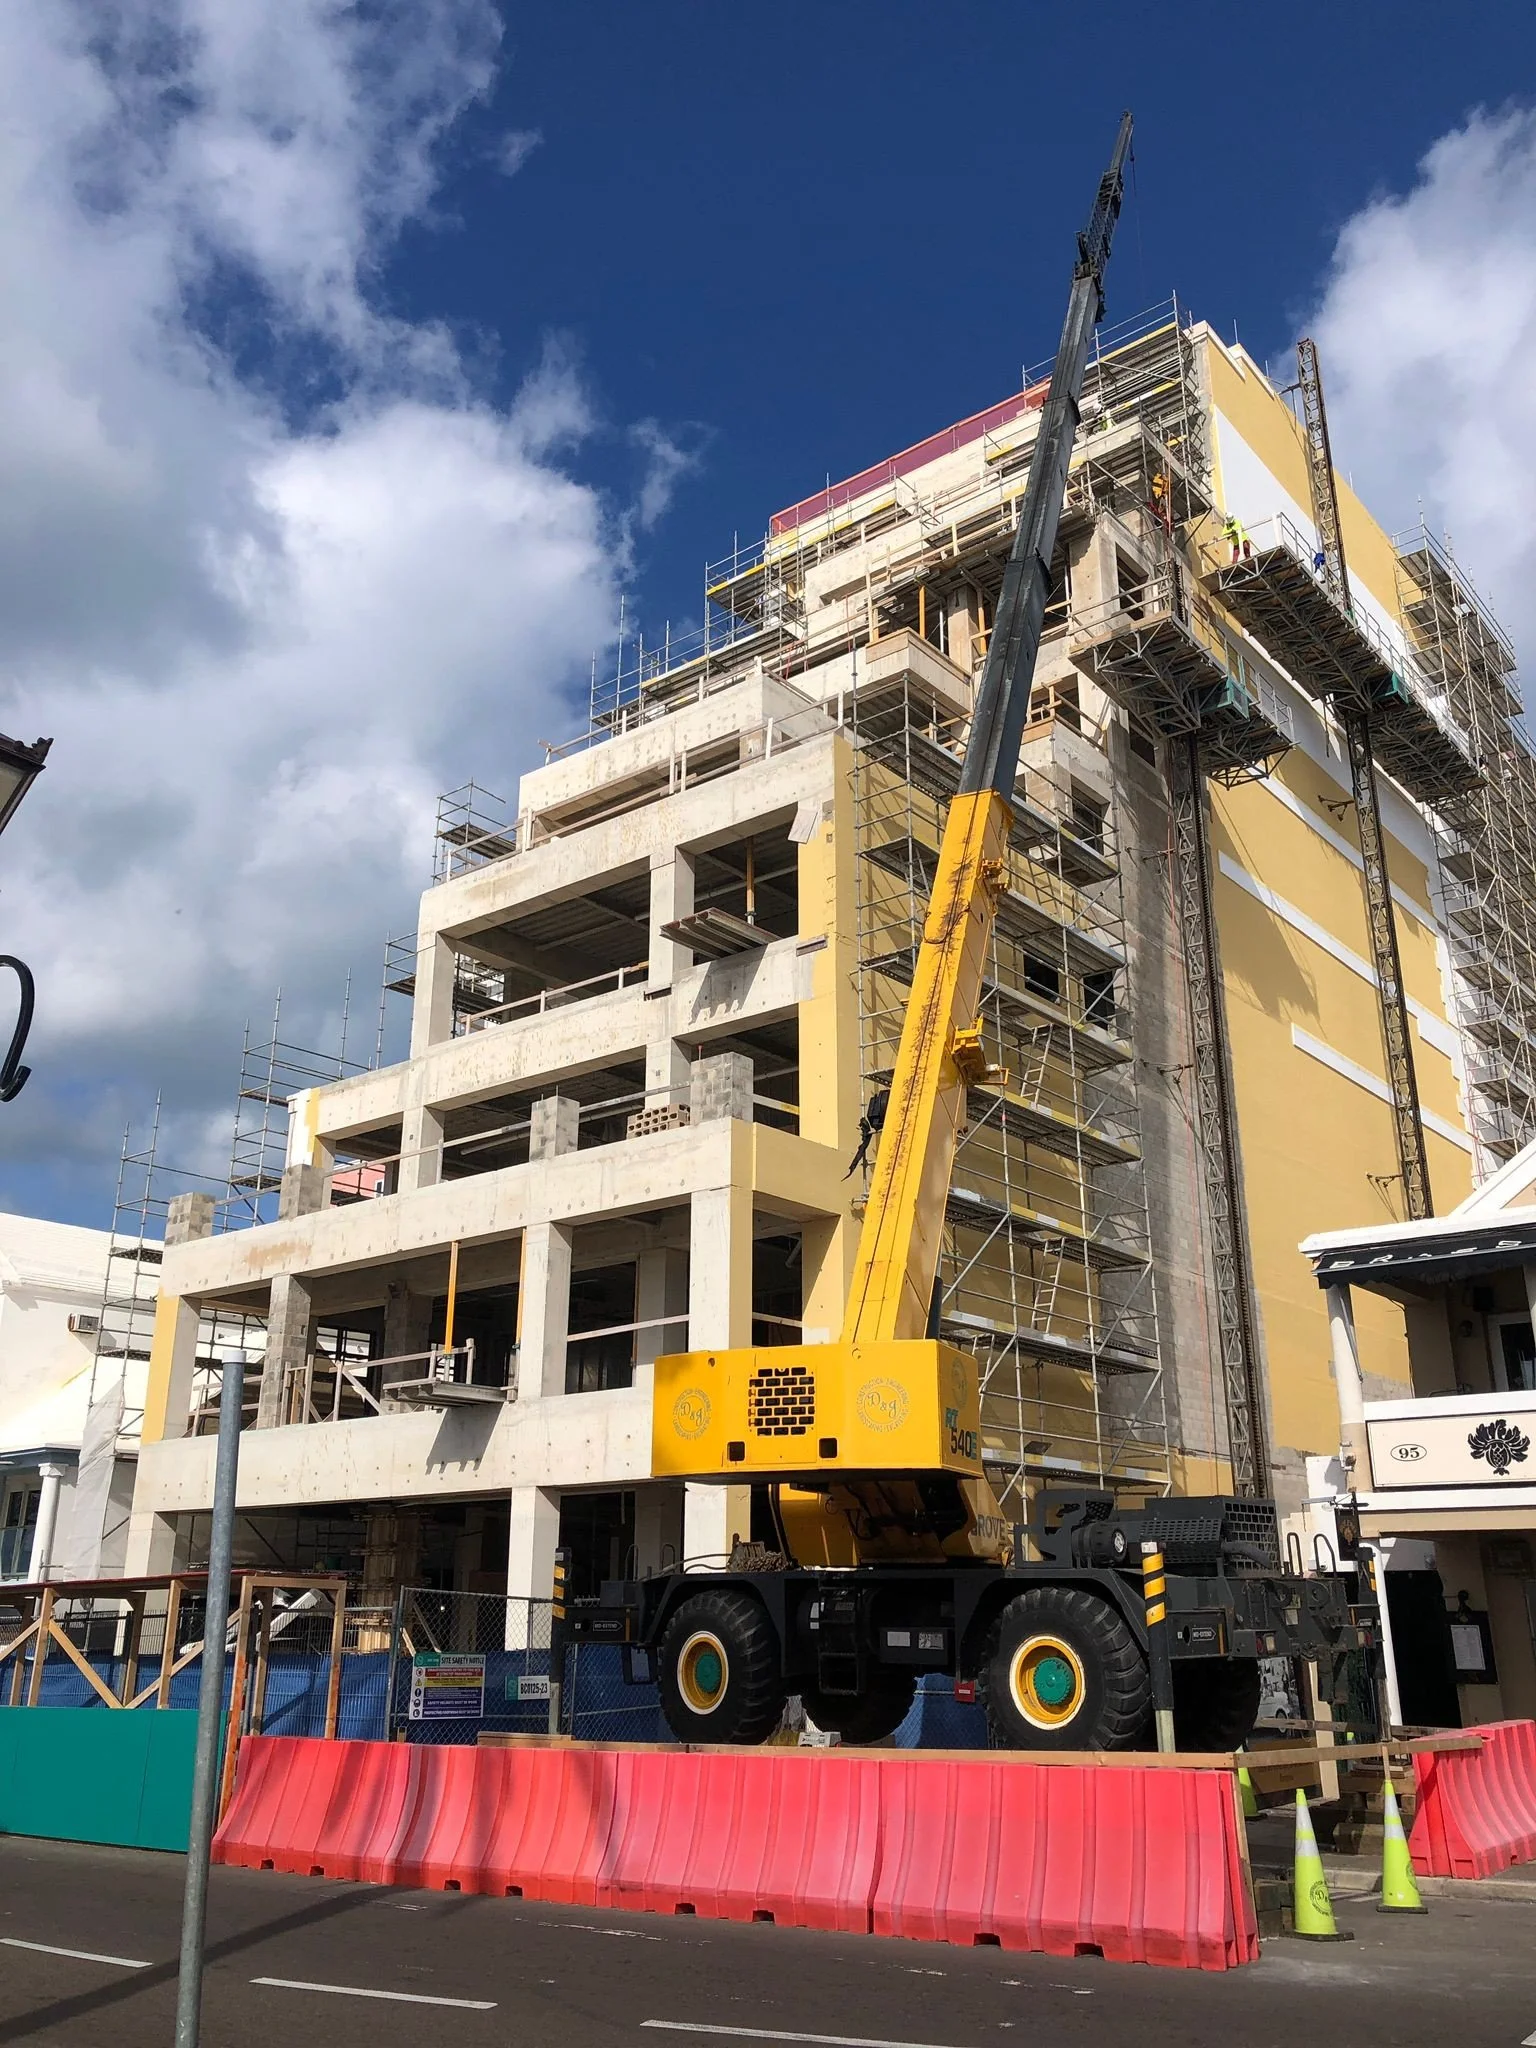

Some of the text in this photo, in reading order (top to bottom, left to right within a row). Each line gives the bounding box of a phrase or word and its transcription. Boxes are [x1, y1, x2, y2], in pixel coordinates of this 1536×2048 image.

[950, 1428, 978, 1460] 540E
[1398, 1447, 1420, 1459] 95
[971, 1513, 1007, 1541] ROVE
[441, 1656, 452, 1665] SITE
[452, 1656, 468, 1665] SAFETY
